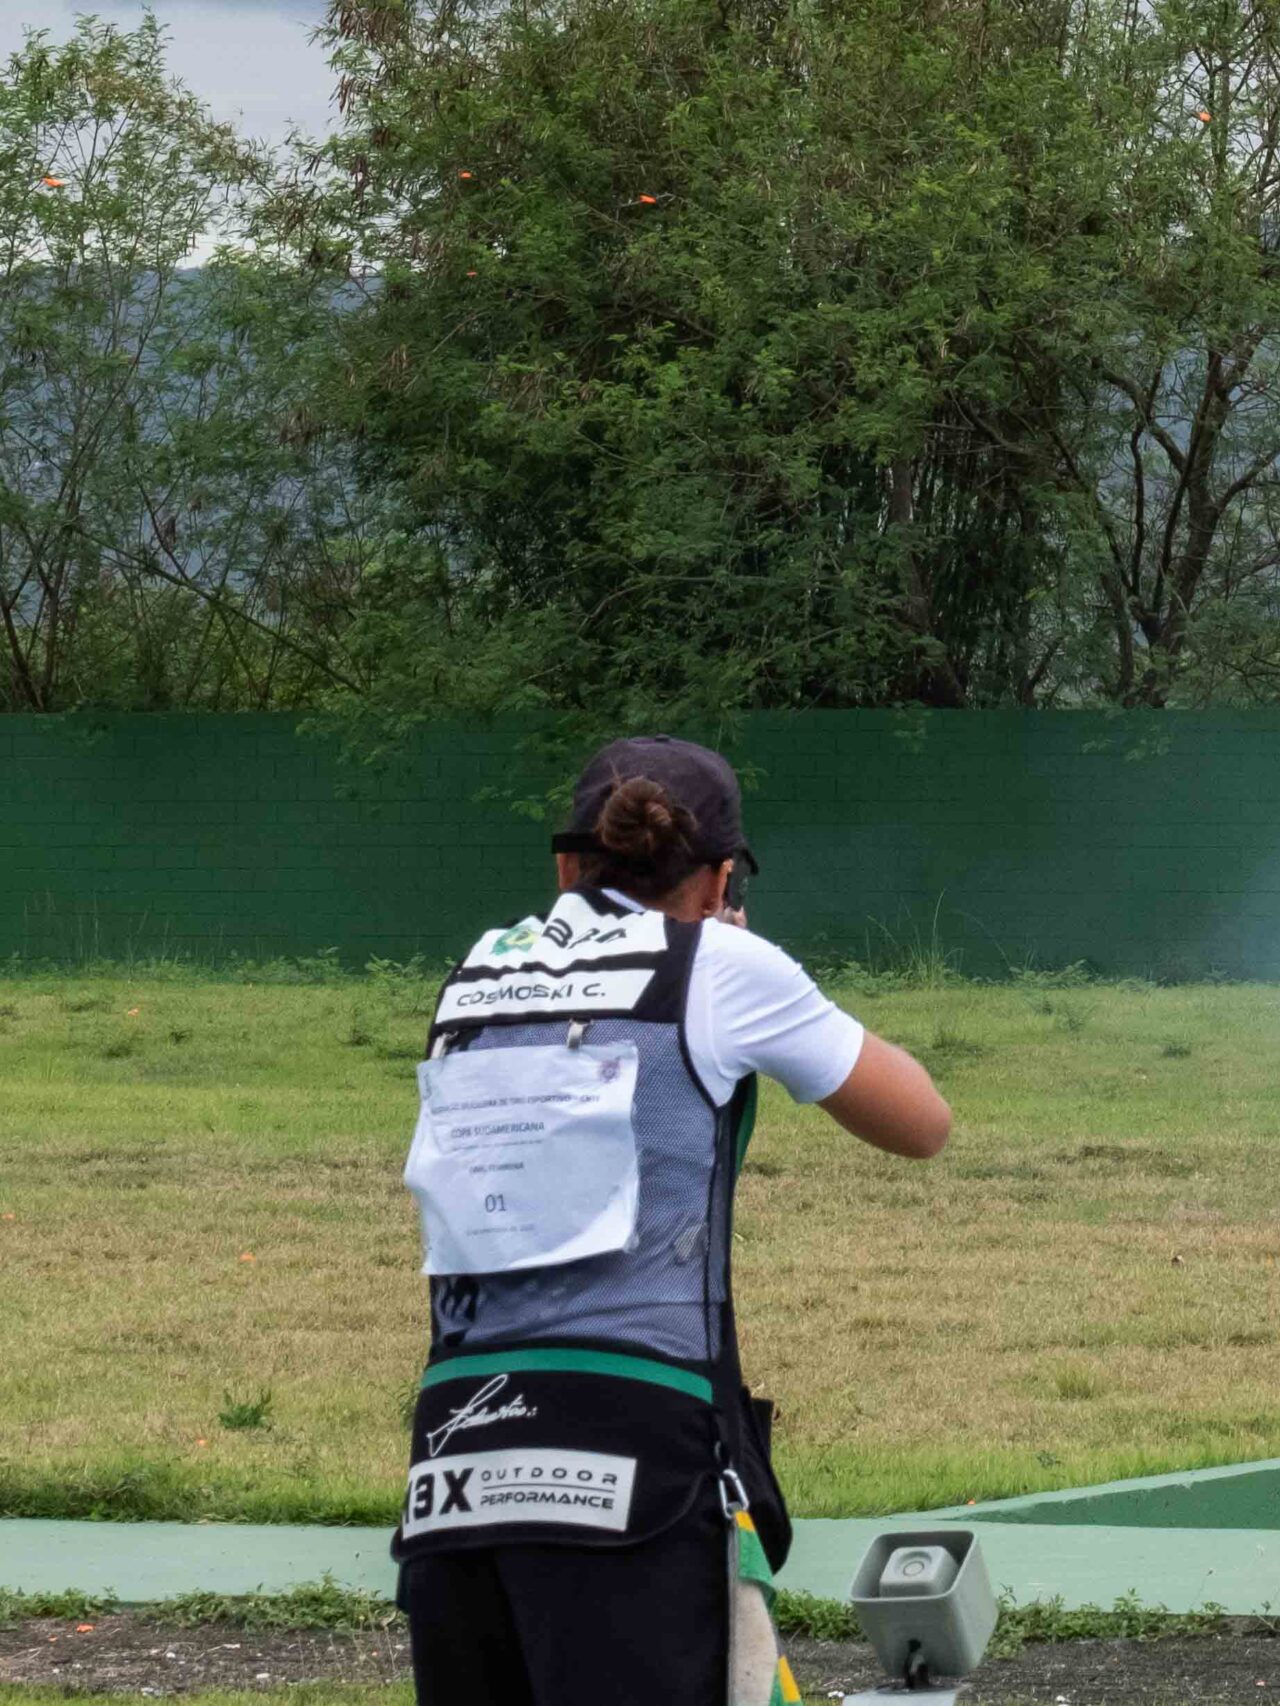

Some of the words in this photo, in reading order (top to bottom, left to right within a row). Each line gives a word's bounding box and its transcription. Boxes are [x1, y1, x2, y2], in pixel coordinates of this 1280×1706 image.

[457, 983, 573, 1006] COSMOSKI
[582, 983, 606, 997] C.
[485, 1194, 507, 1212] 01
[480, 1466, 618, 1486] OUTDOOR
[480, 1490, 615, 1510] PERFORMANCE
